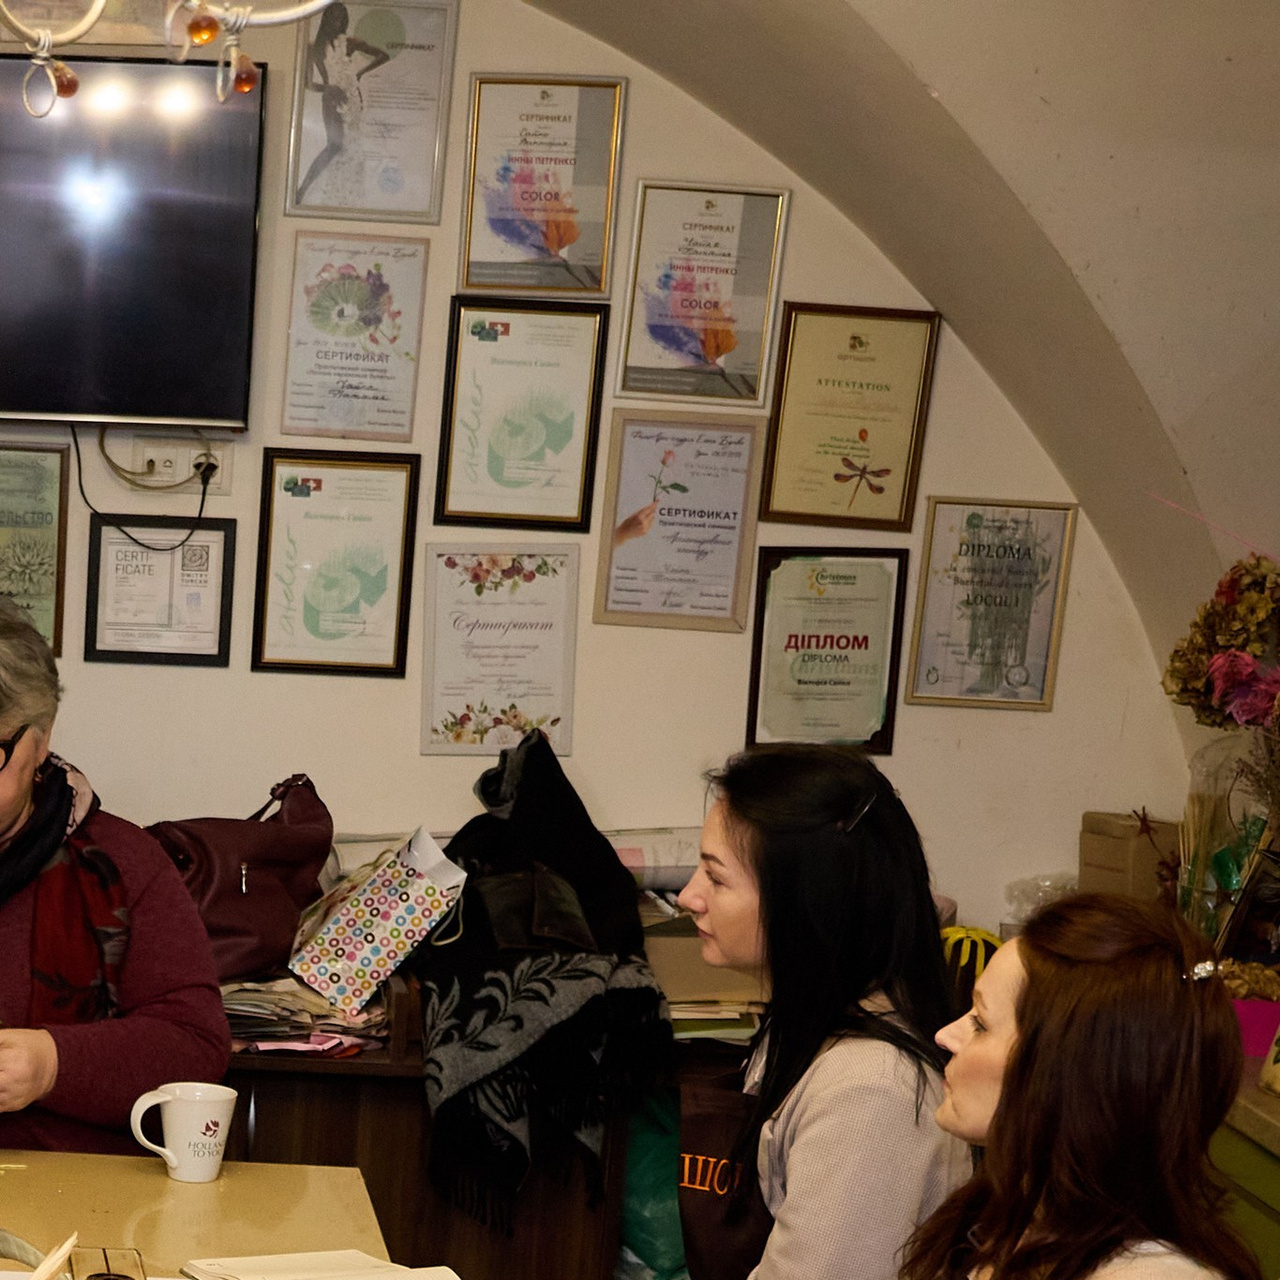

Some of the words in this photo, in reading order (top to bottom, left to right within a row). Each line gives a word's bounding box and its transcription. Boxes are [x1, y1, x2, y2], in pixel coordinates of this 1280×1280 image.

[386, 42, 435, 51] СЕРТИФИКАТ
[519, 113, 572, 123] СЕРТИФИКАТ
[507, 156, 534, 165] ИННЫ
[535, 156, 577, 166] ПЕТРЕНКО
[520, 191, 560, 202] COLOR
[683, 222, 736, 233] СЕРТИФИКАТ
[669, 263, 694, 272] ИННЫ
[696, 265, 738, 276] ПЕТРЕНКО
[680, 298, 720, 310] COLOR
[315, 350, 390, 364] СЕРТИФИКАТ
[816, 378, 891, 392] ATTESTATION
[658, 507, 738, 521] СЕРТИФИКАТ
[958, 543, 1032, 561] DIPLOMA
[114, 564, 155, 576] FICATE
[449, 610, 554, 638] Сертификат
[784, 633, 869, 653] ДІПЛОМ
[802, 654, 850, 664] DIPLOMA
[188, 1141, 224, 1151] HOLLAN
[193, 1150, 206, 1158] TO
